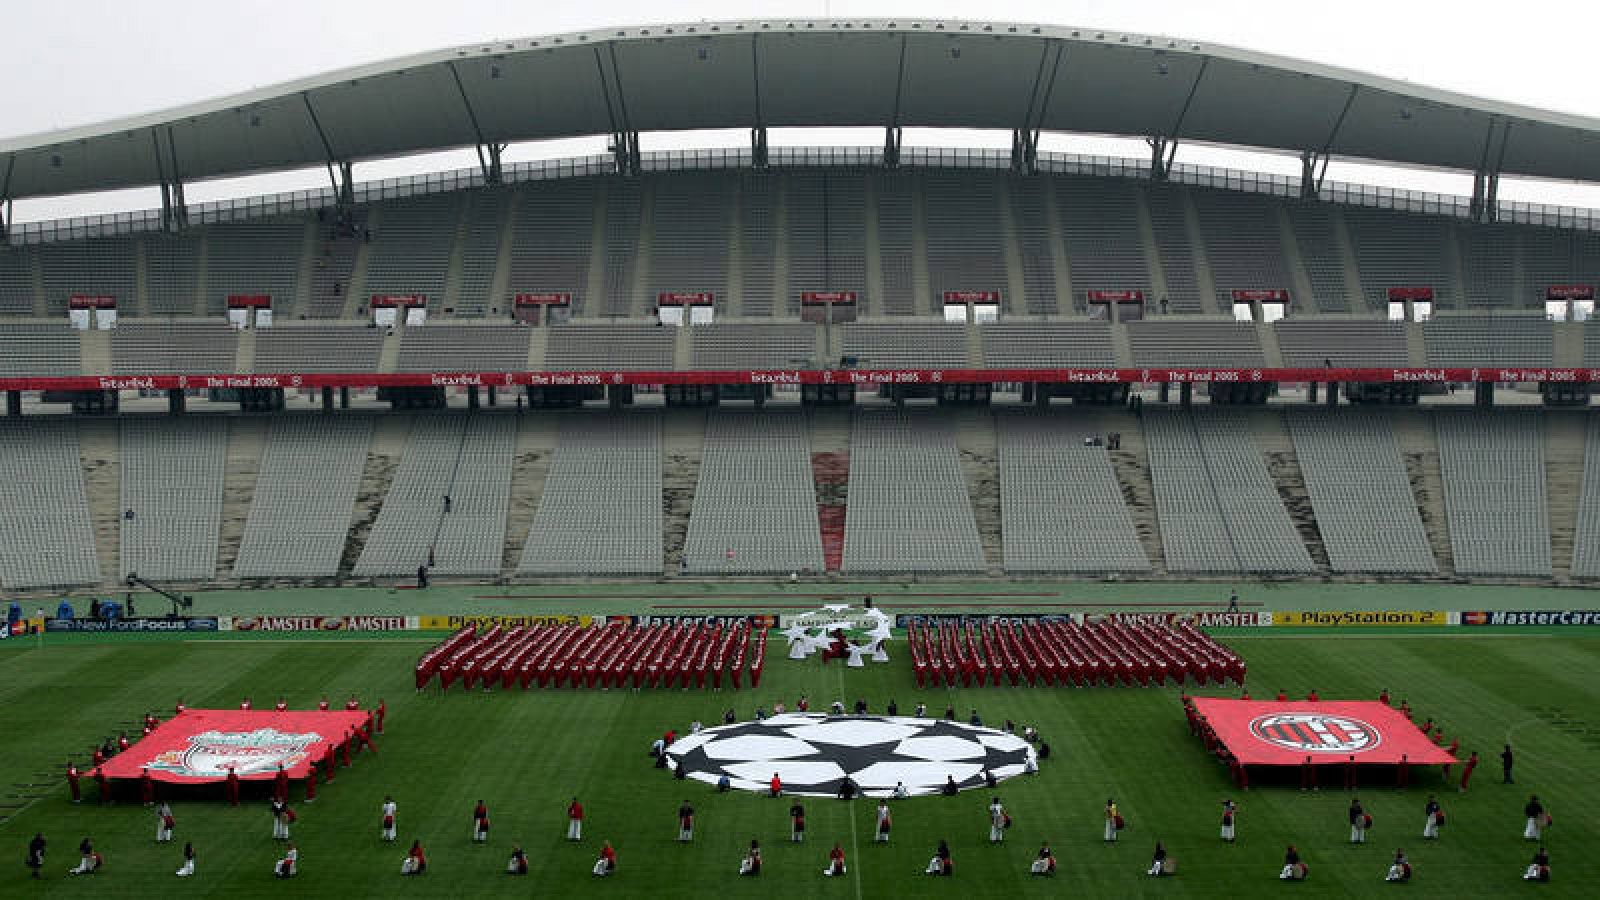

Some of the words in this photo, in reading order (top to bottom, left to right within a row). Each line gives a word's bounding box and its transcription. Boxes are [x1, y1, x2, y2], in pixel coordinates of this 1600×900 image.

[531, 375, 549, 385] The
[551, 375, 575, 385] Final
[577, 375, 601, 385] 2005
[850, 372, 867, 383] The
[870, 372, 893, 383] Final
[896, 372, 919, 383] 2005
[1168, 371, 1185, 381] The
[1188, 371, 1212, 381] Final
[1215, 371, 1239, 381] 2005
[1500, 371, 1519, 381] The
[1521, 371, 1546, 381] Final
[1549, 371, 1576, 381] 2005
[207, 378, 224, 387] The
[227, 378, 251, 387] Final
[254, 378, 278, 387] 2005
[1200, 613, 1257, 626] AMSTEL
[1301, 611, 1413, 624] PlayStation
[1419, 611, 1434, 623] 2
[76, 619, 105, 630] New
[261, 617, 317, 630] AMSTEL
[348, 617, 404, 630] AMSTEL
